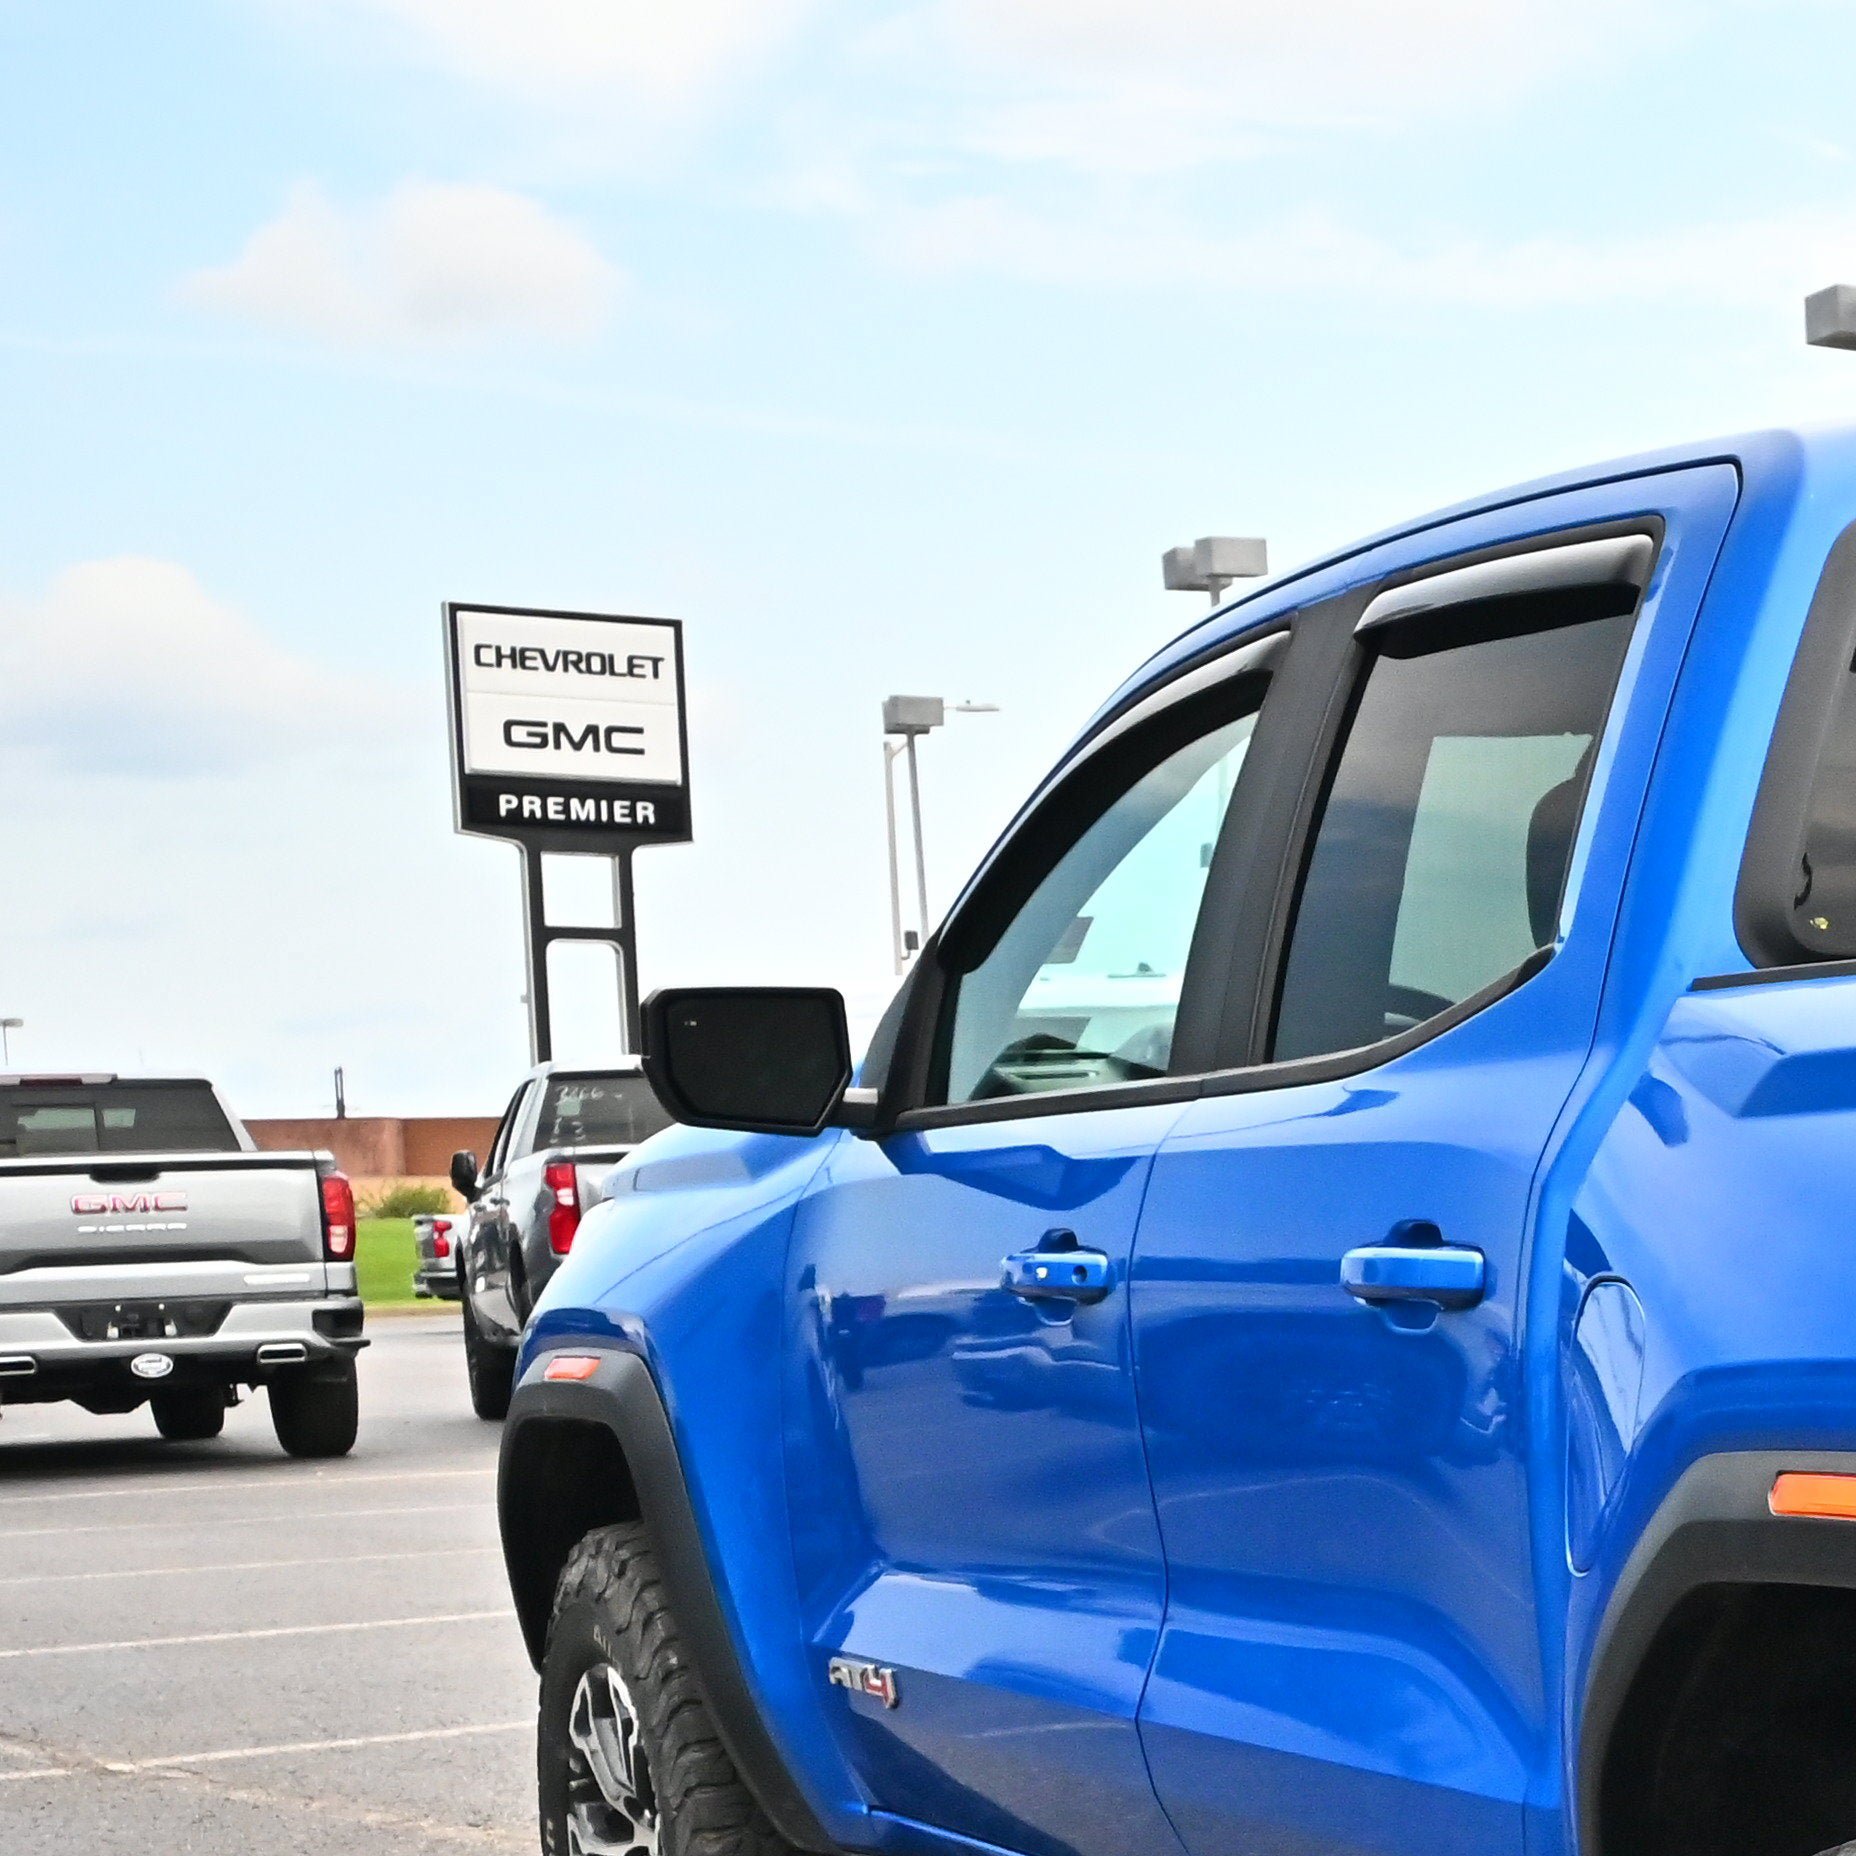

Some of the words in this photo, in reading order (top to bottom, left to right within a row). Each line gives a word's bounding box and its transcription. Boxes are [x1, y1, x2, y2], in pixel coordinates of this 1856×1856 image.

[473, 643, 665, 680] CHEVROLET
[503, 718, 646, 756] GMC
[499, 794, 656, 825] PREMIER
[71, 1191, 188, 1215] GMC
[827, 1656, 898, 1710] AT4
